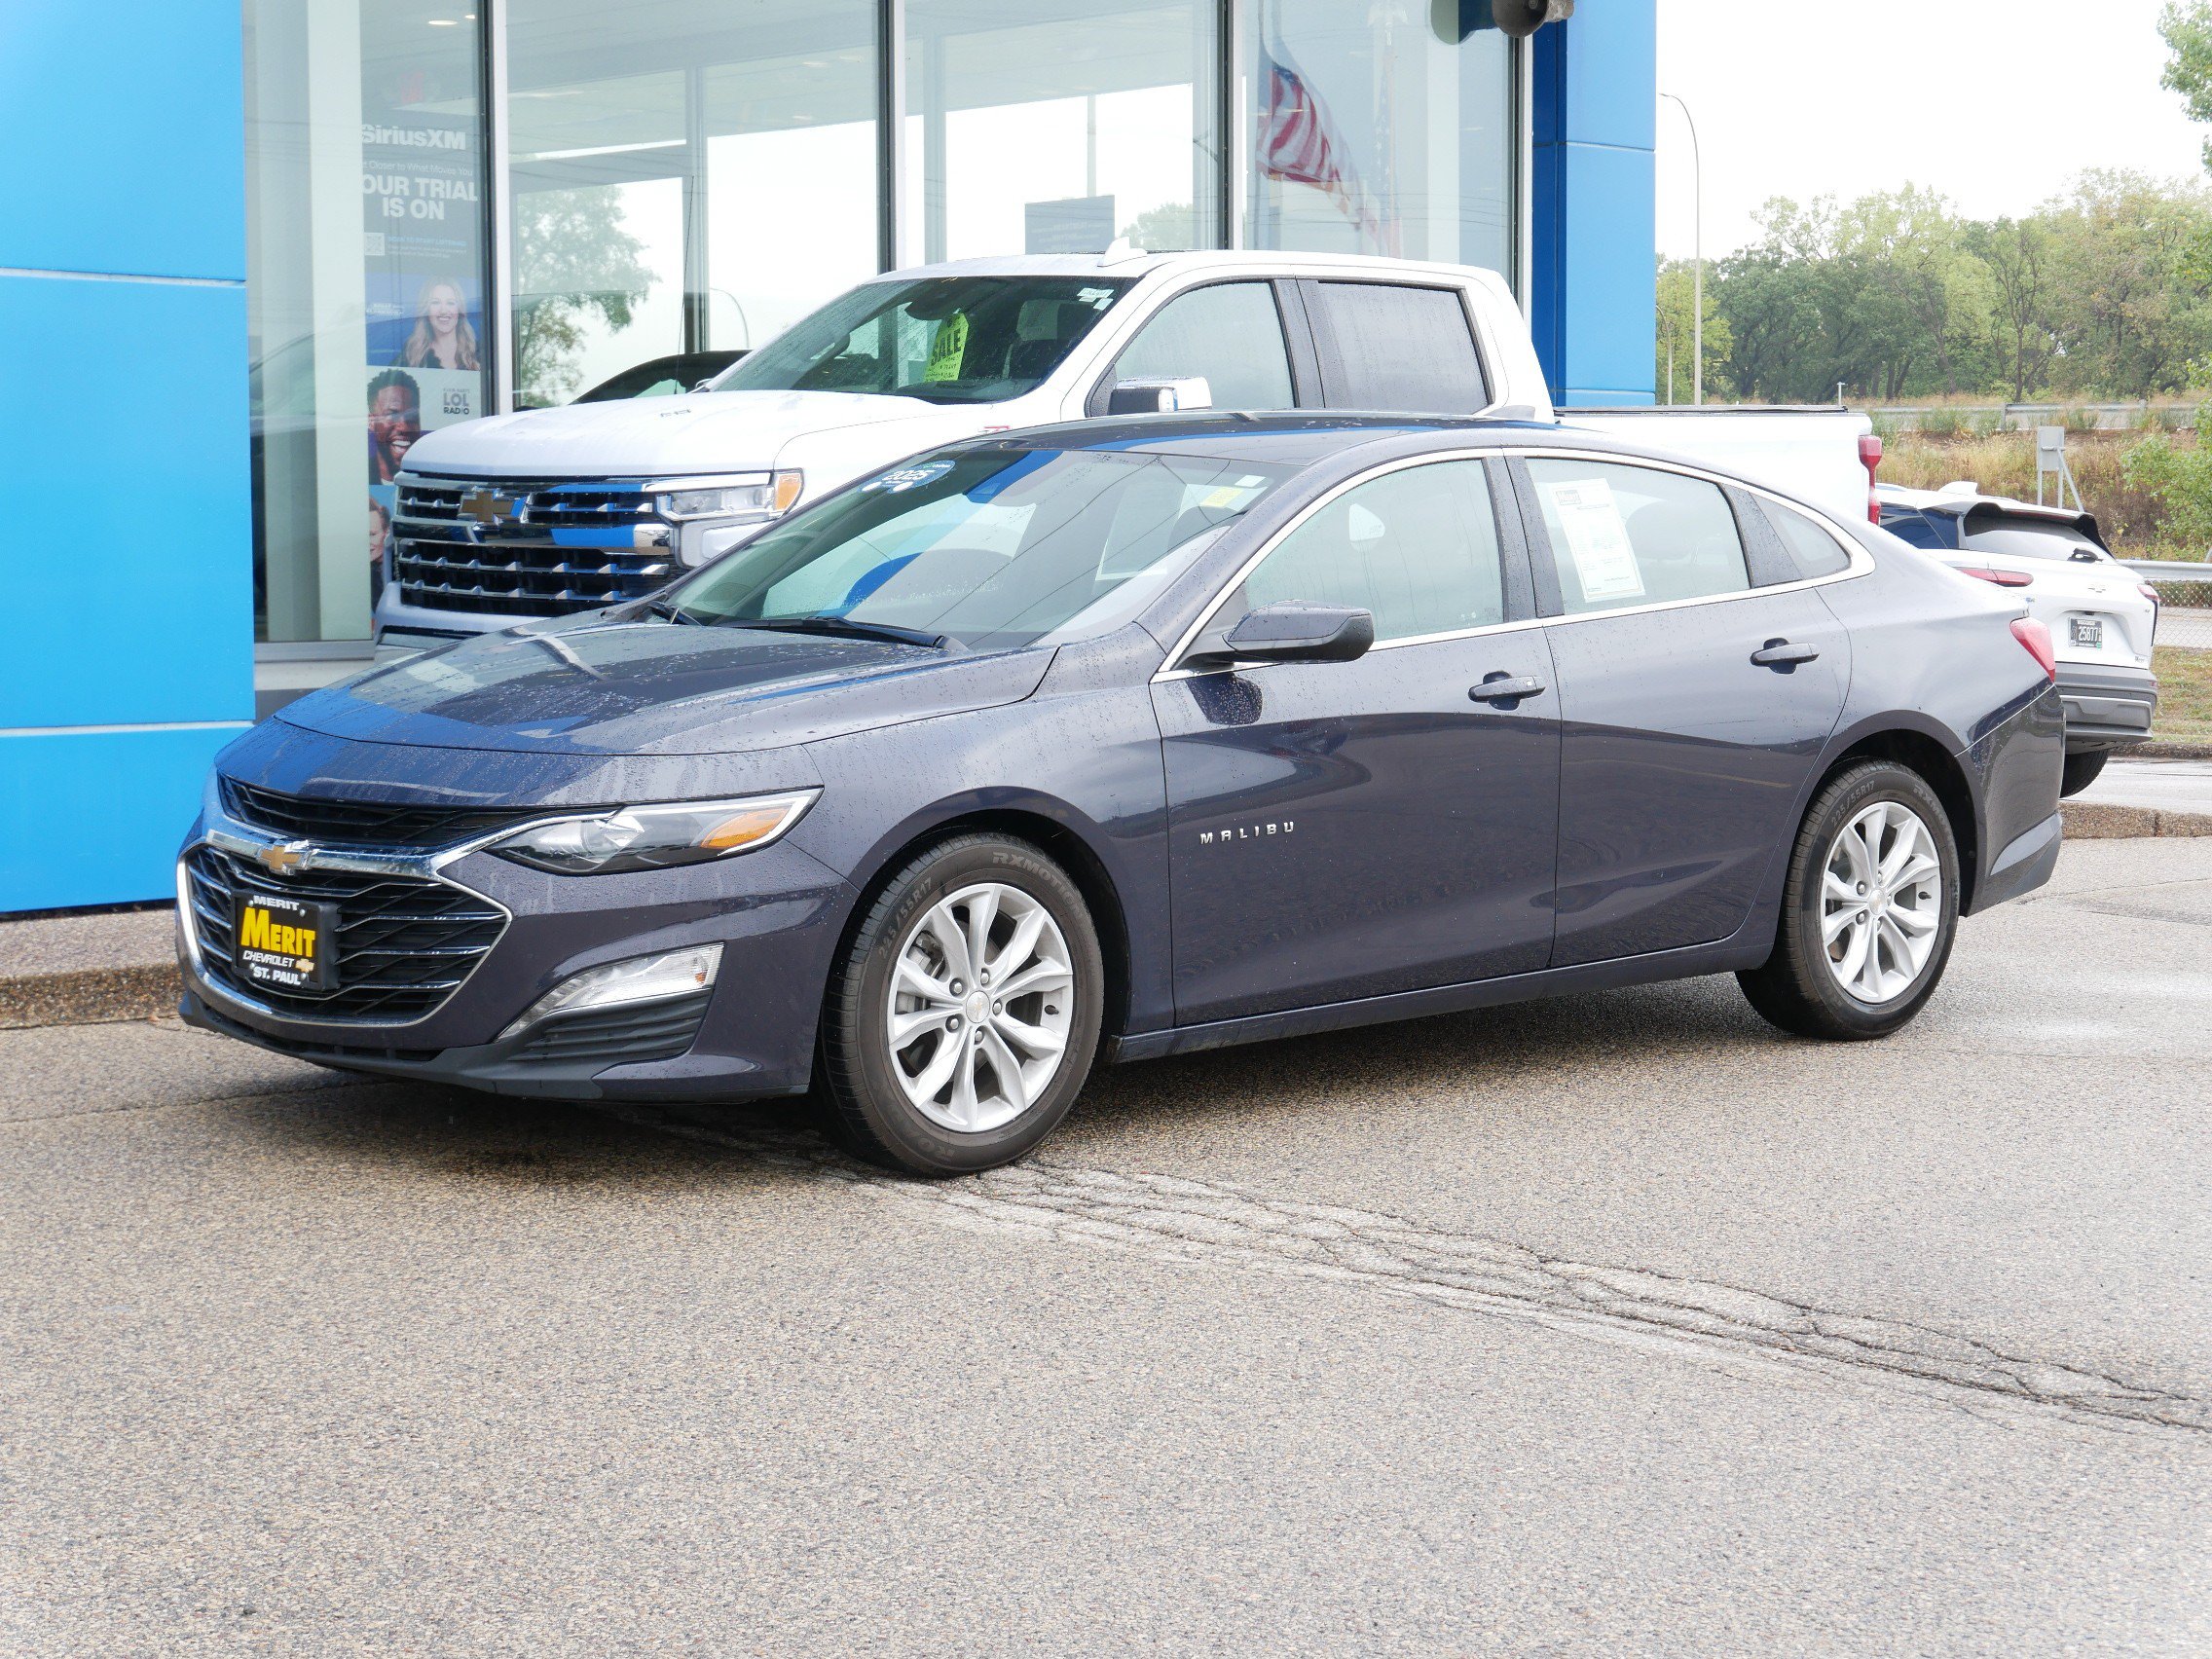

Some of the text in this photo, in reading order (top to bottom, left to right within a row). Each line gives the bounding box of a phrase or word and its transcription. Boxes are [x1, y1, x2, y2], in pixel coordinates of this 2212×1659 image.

[361, 124, 466, 150] SiriusXM
[459, 167, 473, 176] You
[362, 174, 478, 202] OUR TRIAL
[383, 197, 445, 220] IS ON
[931, 328, 962, 366] SALE
[443, 392, 470, 407] LOL
[1199, 821, 1295, 845] MALIBU
[252, 895, 300, 911] MERIT
[242, 950, 295, 969] CHEVROLET
[252, 966, 302, 986] ST. PAUL
